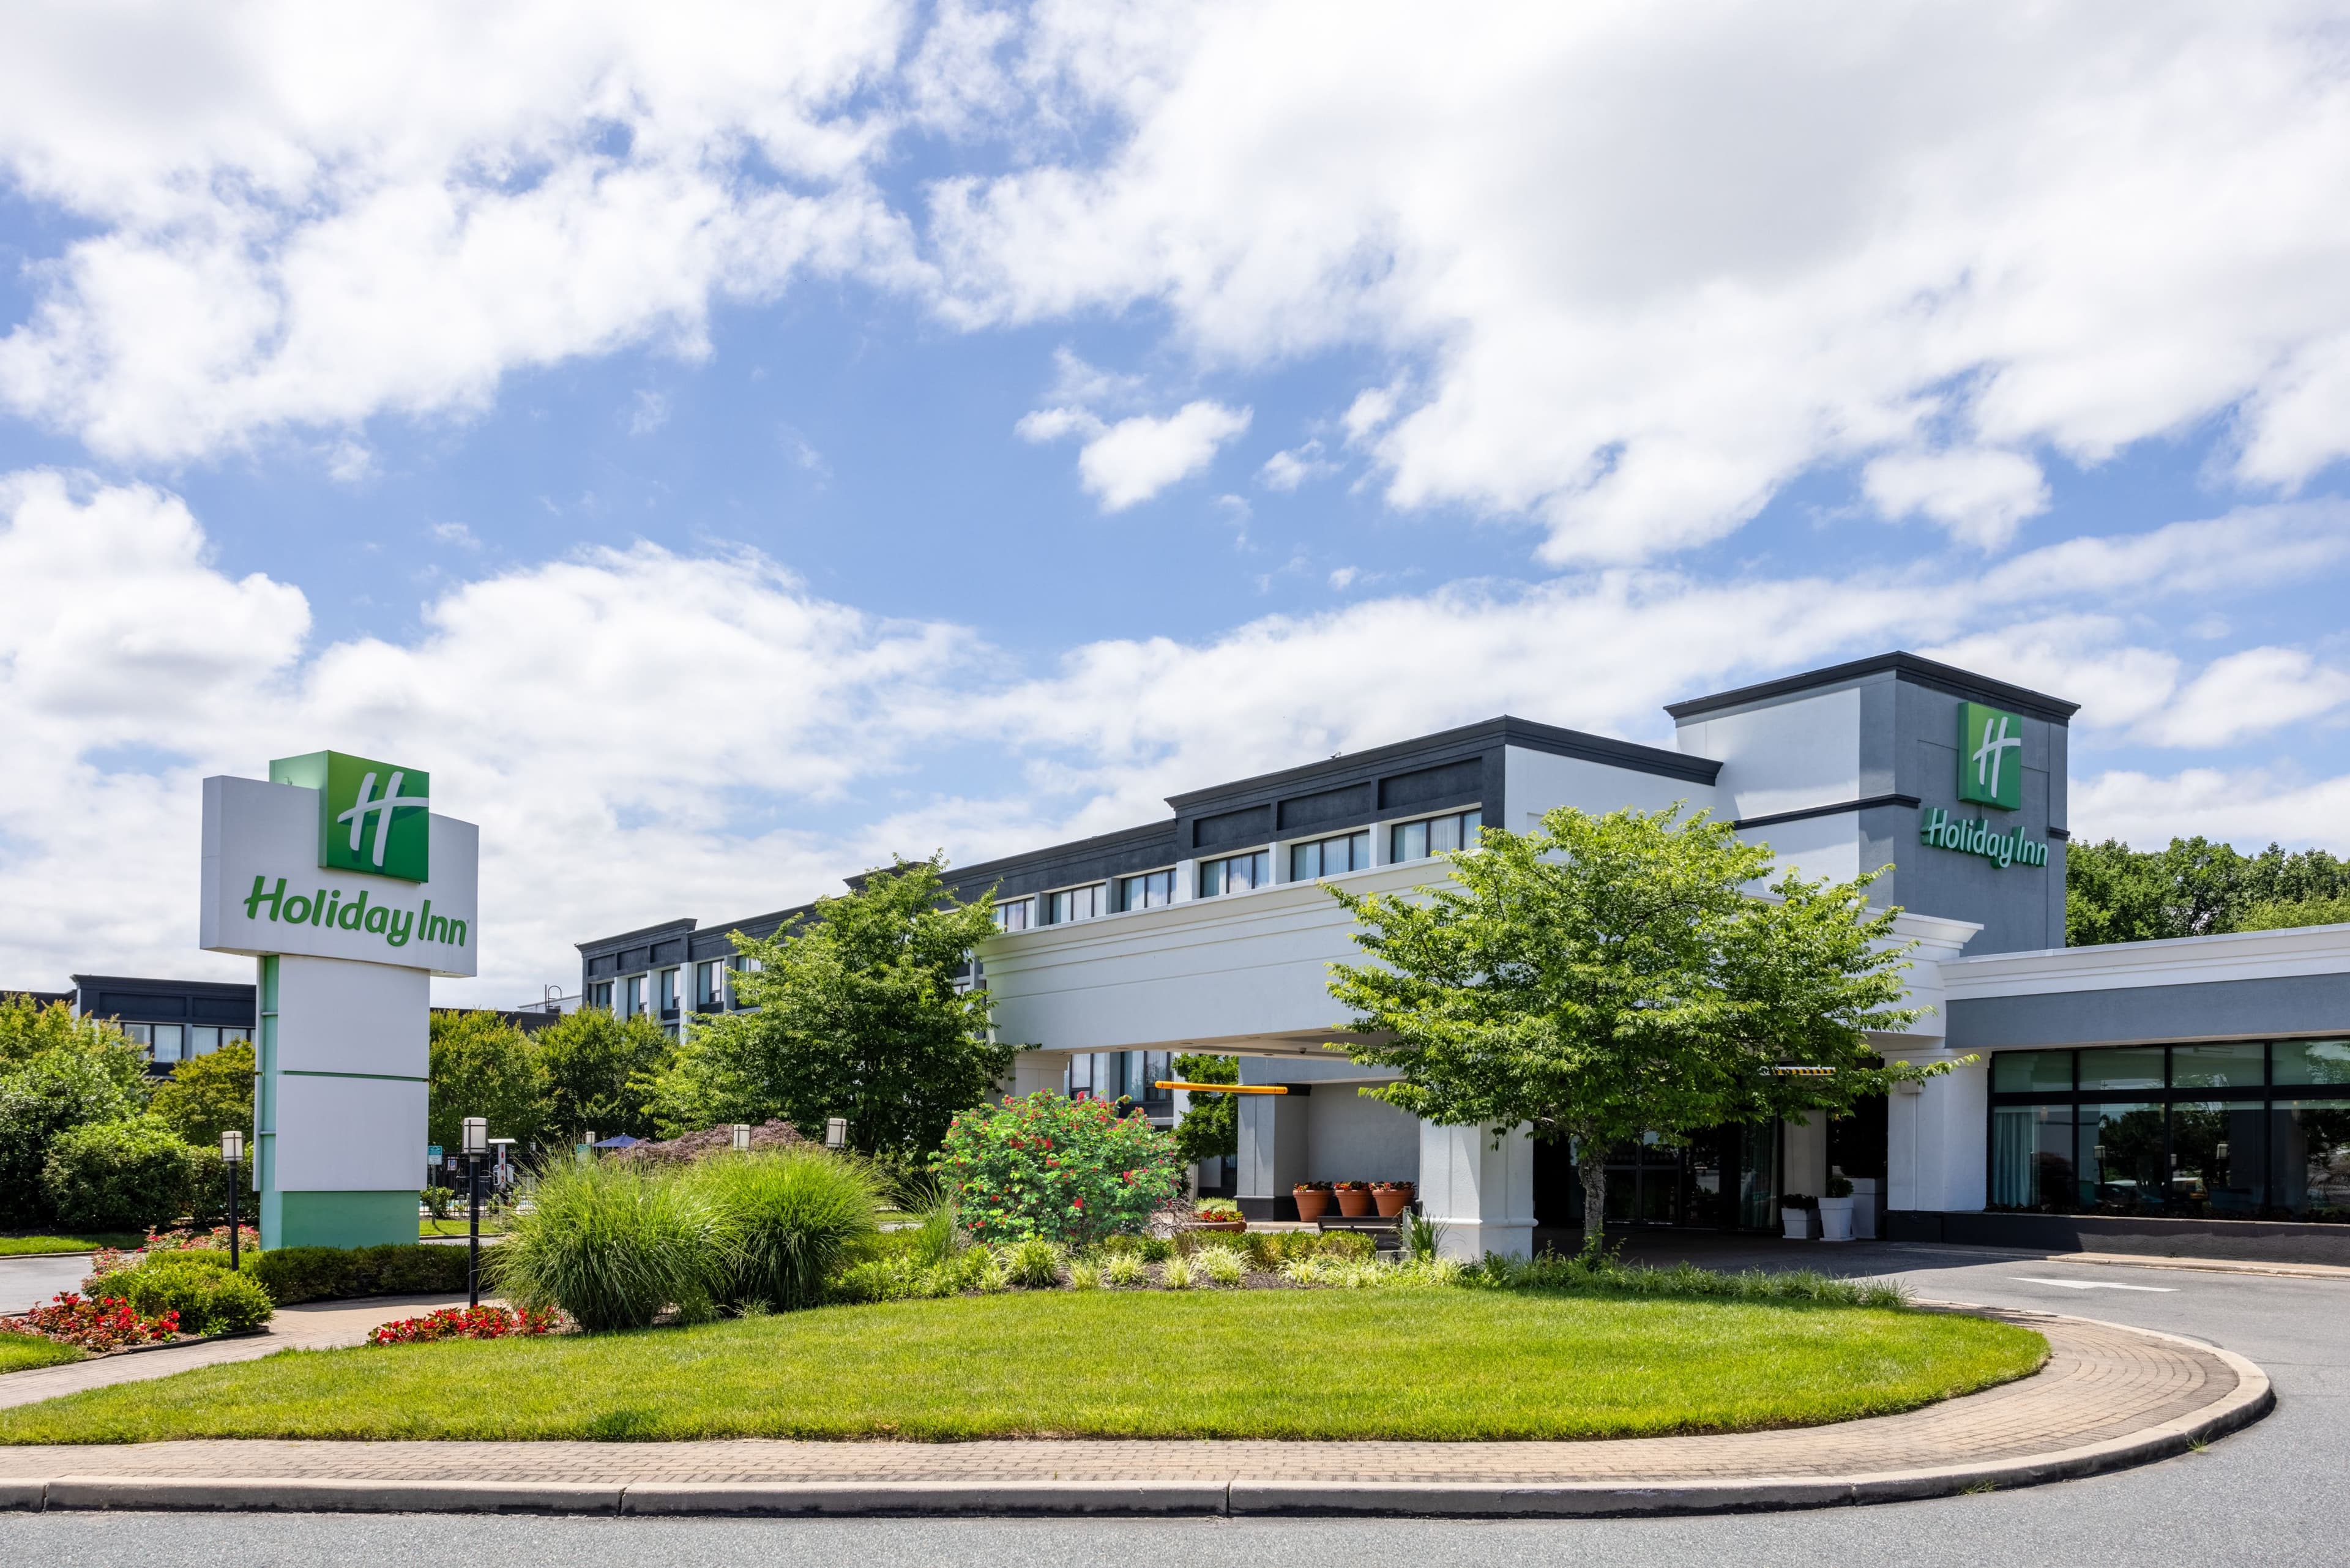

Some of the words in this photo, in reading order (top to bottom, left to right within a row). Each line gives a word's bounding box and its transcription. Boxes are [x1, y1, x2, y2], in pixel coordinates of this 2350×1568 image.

[1925, 807, 2013, 868] Holiday
[2016, 826, 2048, 866] Inn
[244, 876, 414, 947] Holiday
[418, 900, 467, 947] Inn
